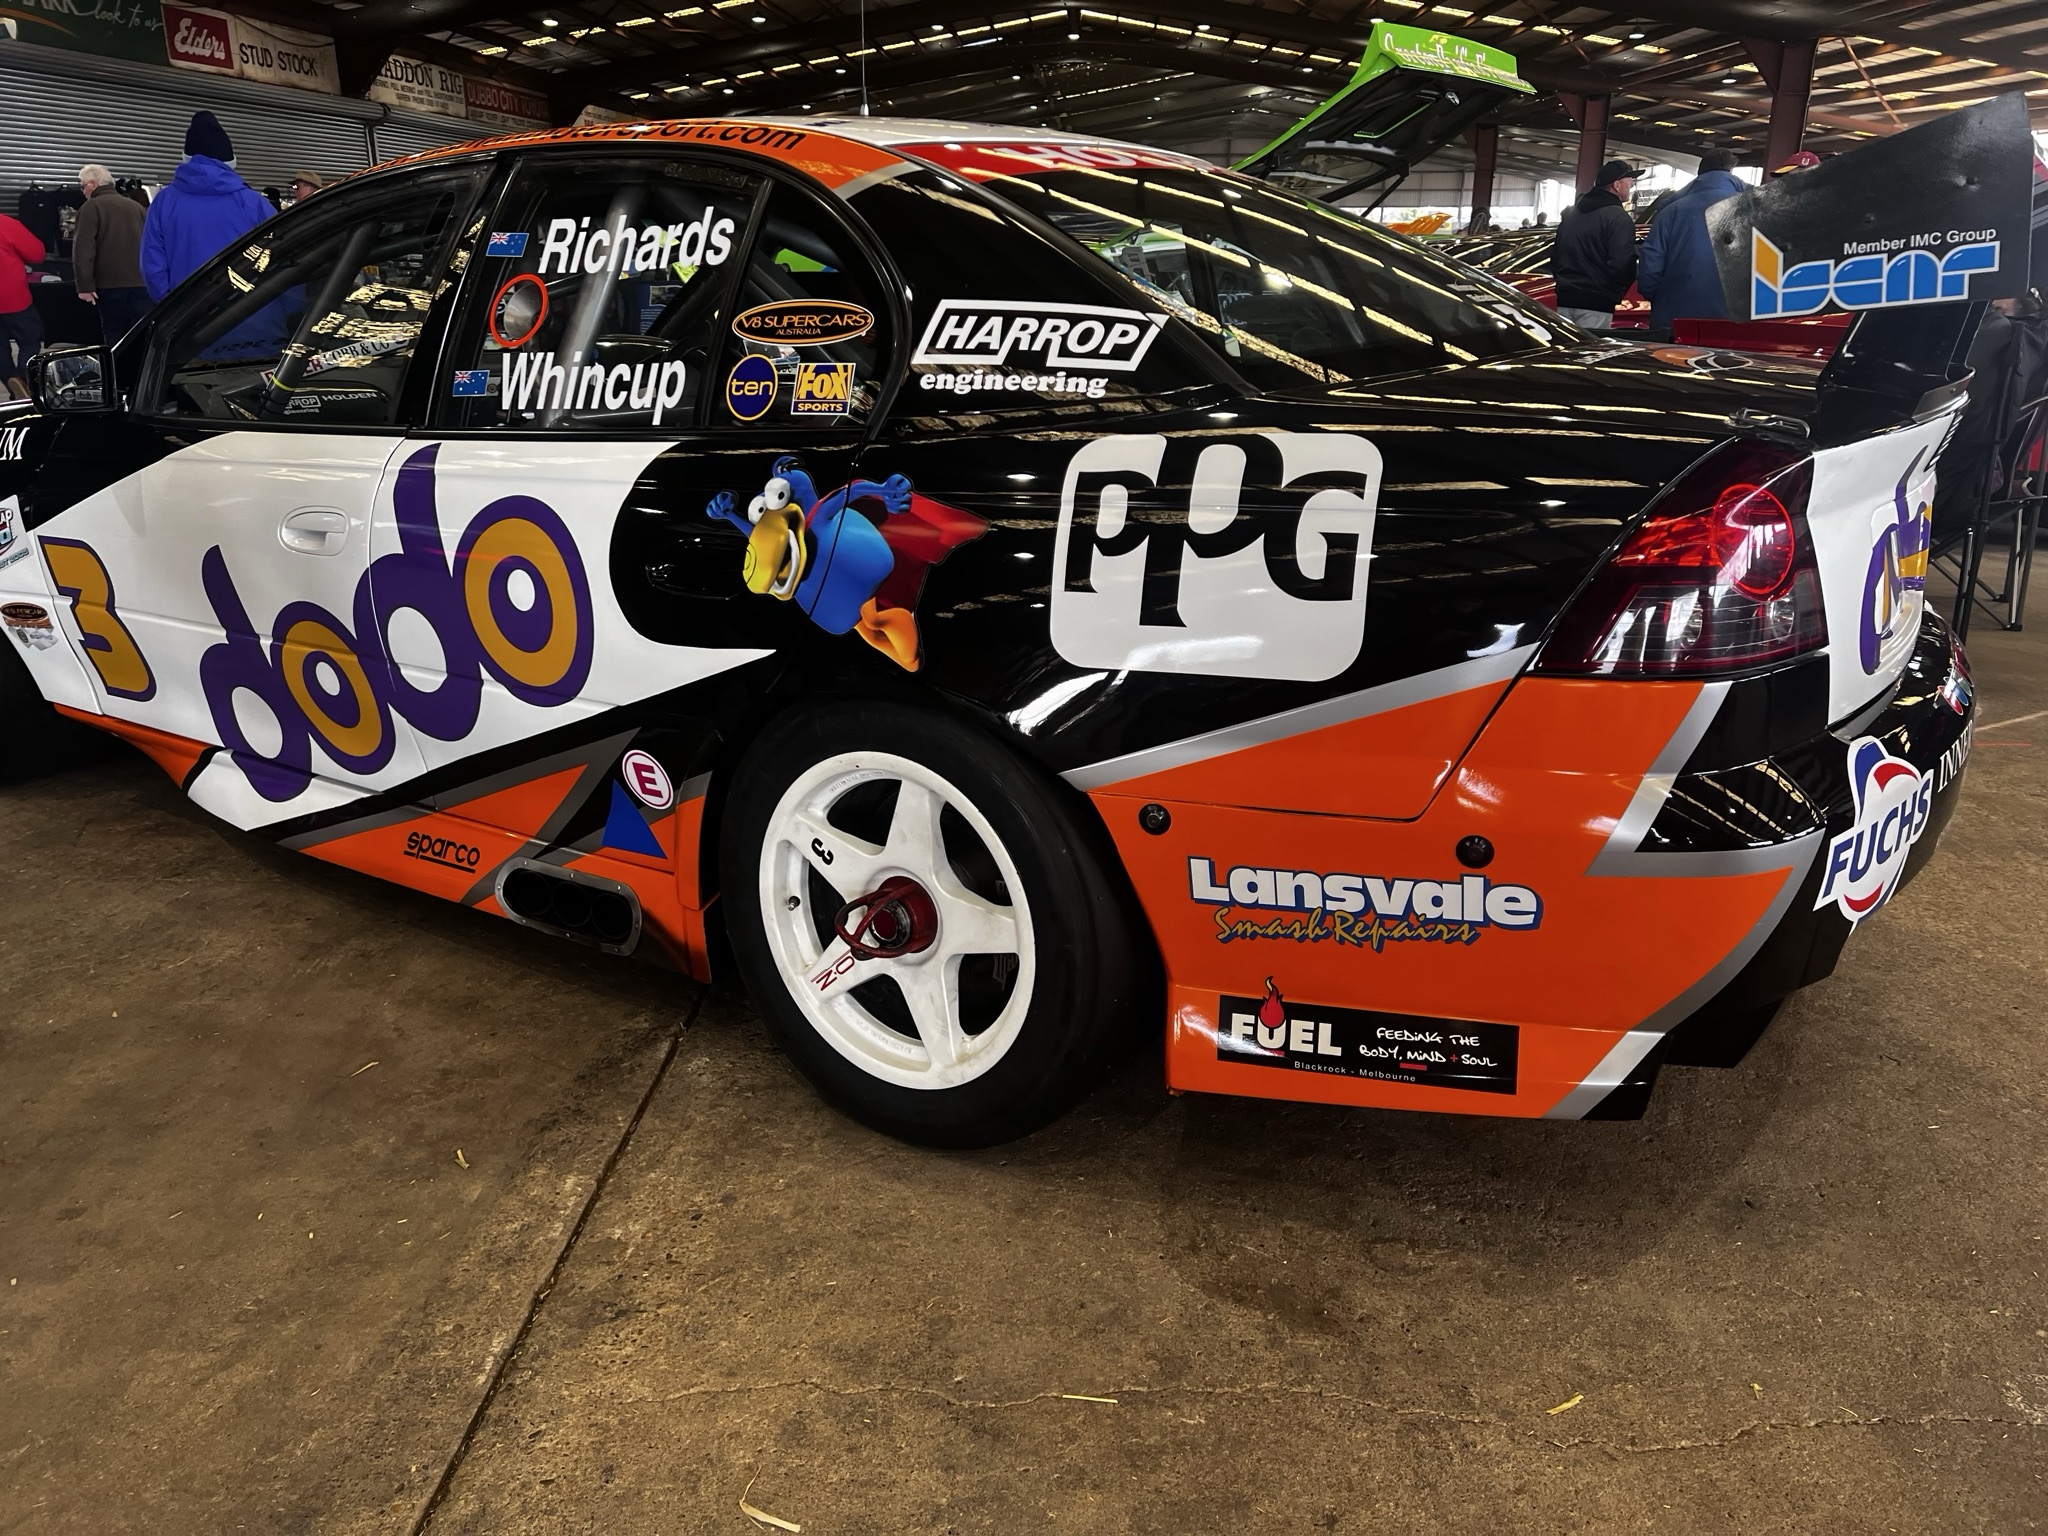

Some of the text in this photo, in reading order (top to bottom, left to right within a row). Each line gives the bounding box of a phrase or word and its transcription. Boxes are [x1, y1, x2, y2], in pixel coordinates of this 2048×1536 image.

[128, 3, 145, 29] to
[173, 17, 227, 60] Elders
[239, 42, 319, 77] STUD STOCK
[380, 58, 464, 95] ADDON RIG
[467, 81, 499, 109] DUBBO
[499, 87, 520, 113] CITY
[538, 206, 735, 274] Richards
[1843, 227, 1998, 256] Member IMC Group
[742, 312, 870, 330] V8 SUPERCARS
[775, 328, 822, 336] AUSTRALIA
[932, 312, 1143, 362] HARROP
[321, 392, 378, 402] HOLDEN
[500, 350, 687, 426] Whincup
[731, 378, 774, 396] ten
[798, 371, 849, 400] FOX
[918, 366, 1110, 399] engineering
[284, 407, 321, 416] gineering
[287, 397, 316, 408] RROP
[797, 402, 843, 412] SPORTS
[1063, 433, 1370, 628] PPG
[37, 534, 157, 702] 3
[199, 442, 595, 803] dodo
[631, 761, 662, 799] E
[404, 830, 480, 868] sparco
[809, 837, 835, 867] 3
[1822, 776, 1932, 899] FUCHS
[1188, 856, 1541, 929] Lansvale
[1215, 905, 1480, 953] Smash Repairs
[1230, 1012, 1342, 1057] FUEL
[1449, 1033, 1481, 1047] THE
[1293, 1060, 1347, 1075] Blackrock
[1359, 1068, 1416, 1083] Melbourne
[1460, 1053, 1498, 1068] SOUL
